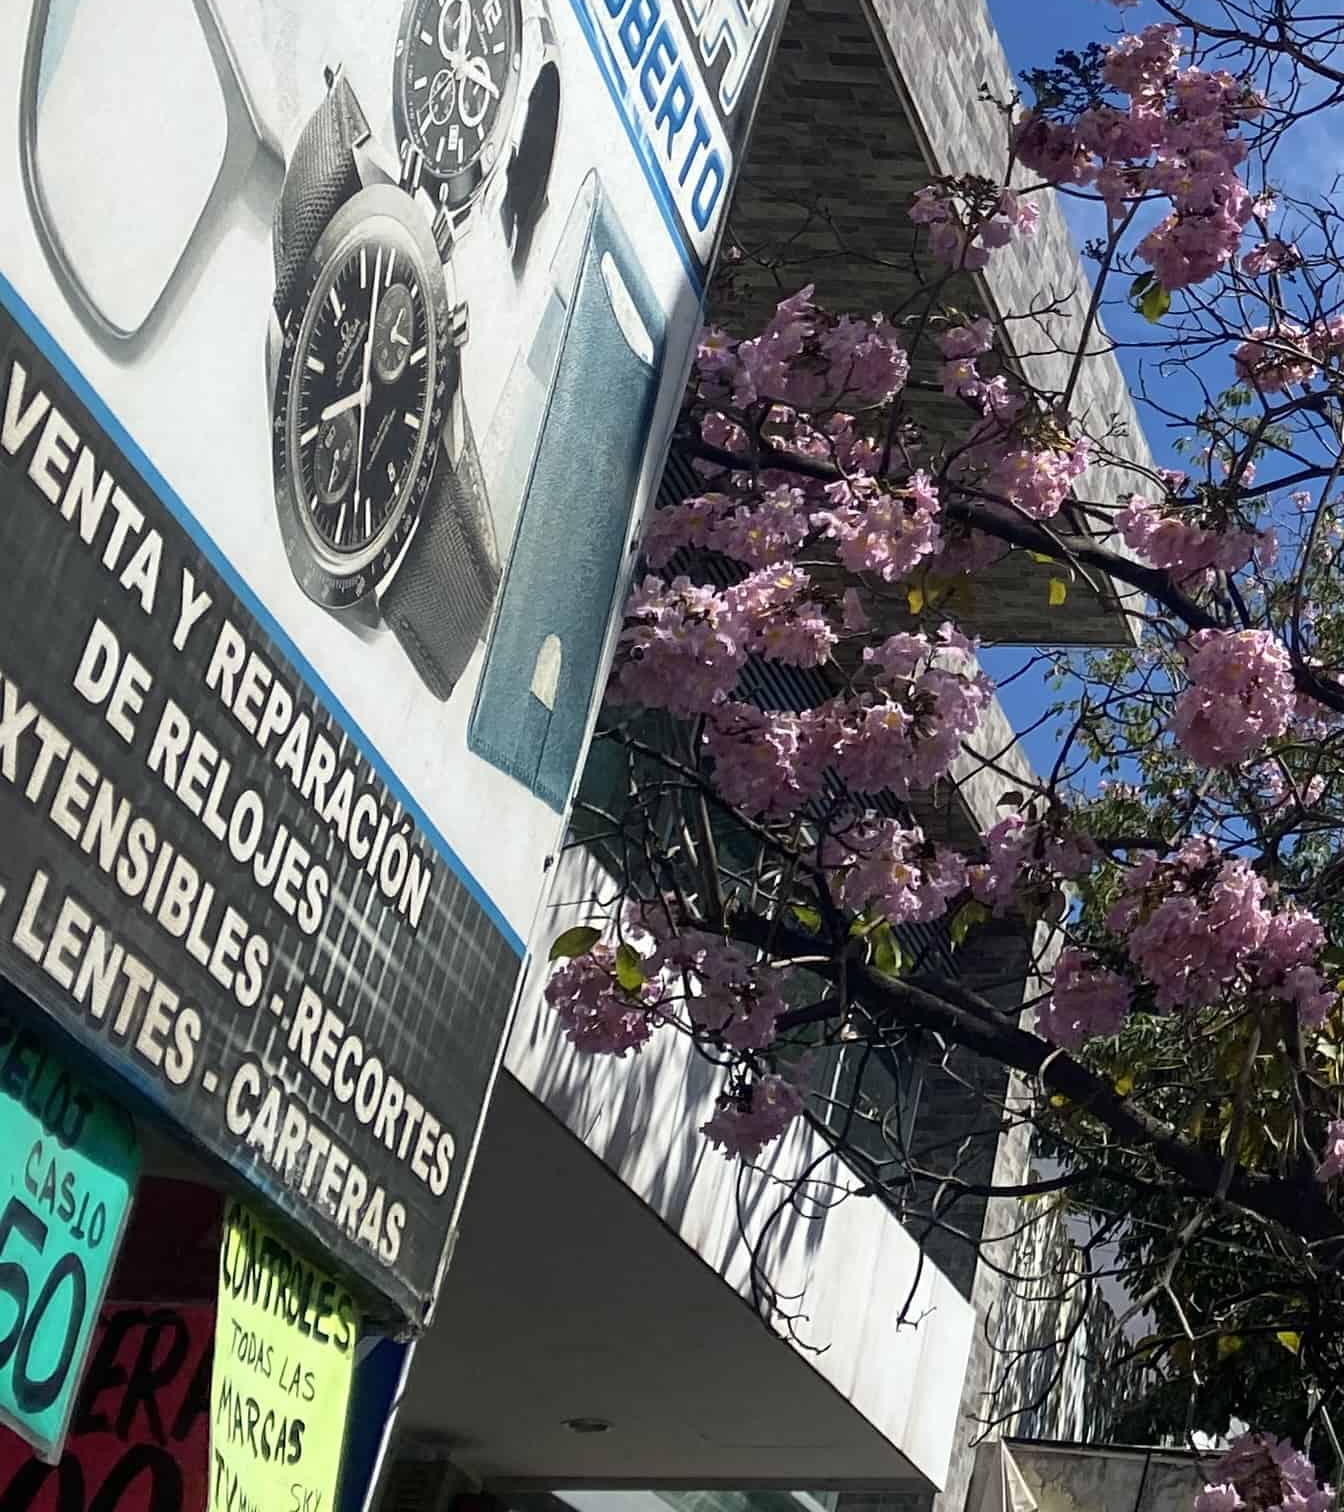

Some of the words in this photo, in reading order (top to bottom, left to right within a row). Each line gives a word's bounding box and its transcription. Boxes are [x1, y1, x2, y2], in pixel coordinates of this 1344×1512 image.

[1, 360, 164, 615] VENTA
[172, 567, 213, 651] Y
[206, 620, 431, 929] REPARACIÓN
[73, 618, 153, 744] DE
[146, 698, 330, 936] RELOJES
[0, 670, 270, 1008] XTENSIBLES
[288, 984, 457, 1198] RECORTES
[13, 869, 202, 1085] LENTES
[225, 1061, 408, 1267] CARTERAS
[24, 1139, 107, 1249] CASIO
[217, 1375, 306, 1466] MARCAS
[231, 1317, 275, 1379] TODAS
[278, 1355, 316, 1403] LAS
